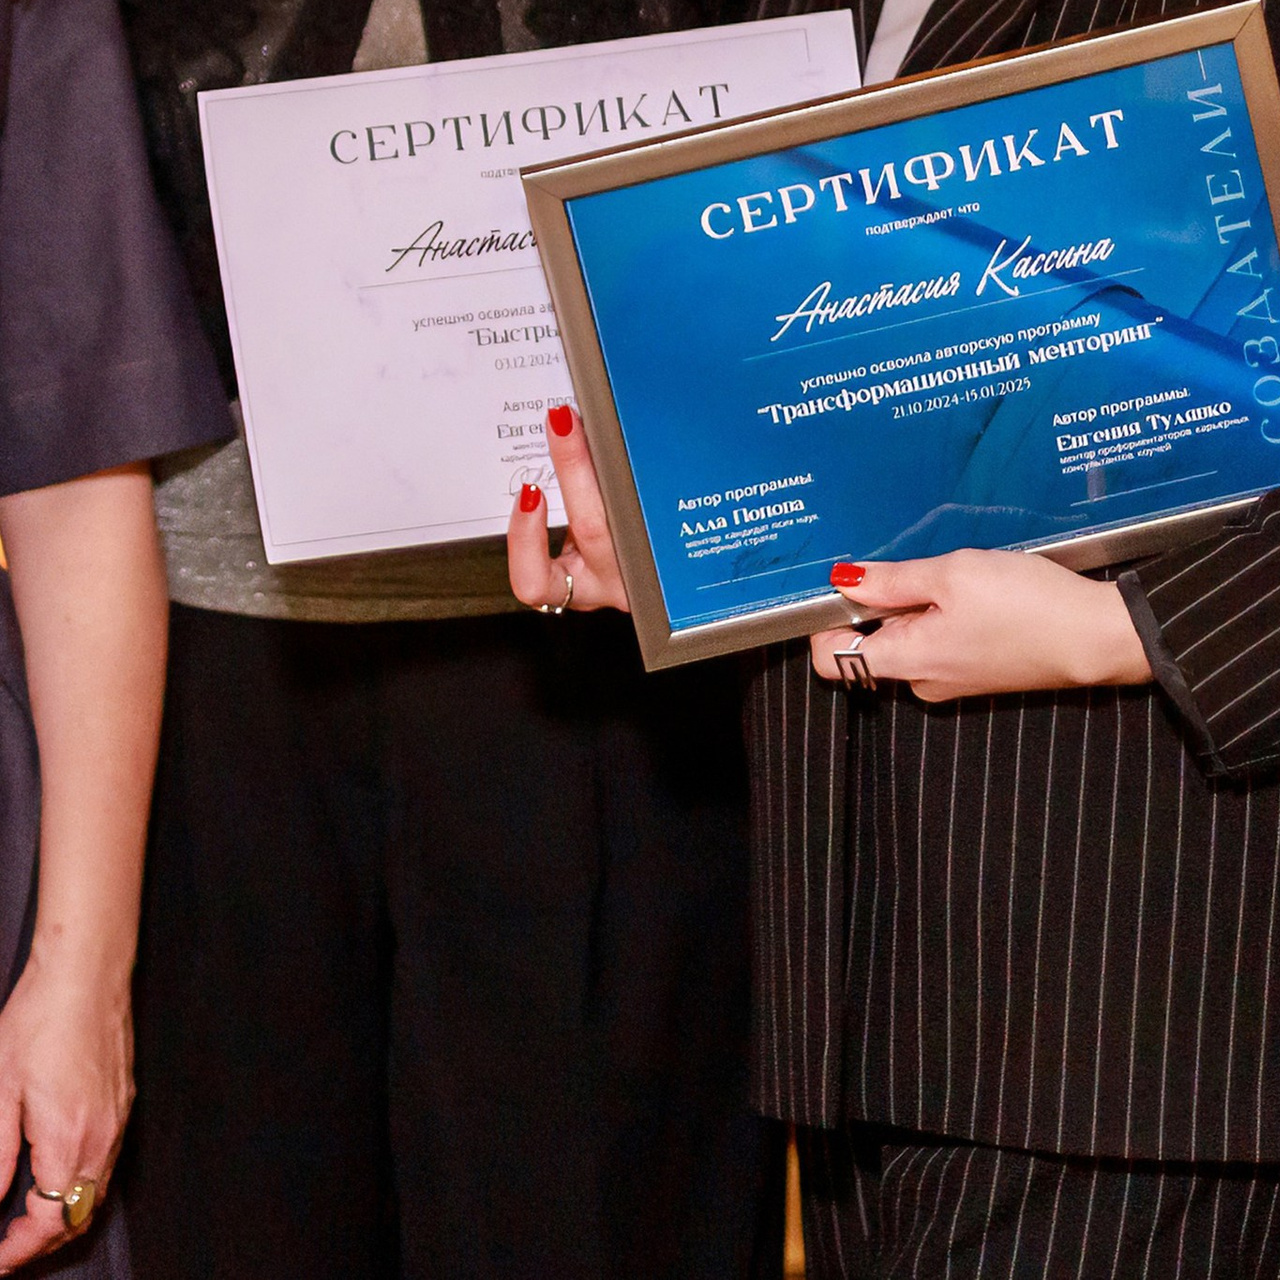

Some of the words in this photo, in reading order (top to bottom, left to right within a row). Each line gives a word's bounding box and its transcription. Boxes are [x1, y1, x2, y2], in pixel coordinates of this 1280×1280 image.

[329, 83, 730, 165] СЕРТИФИКАТ
[700, 109, 1124, 239] СЕРТИФИКАТ
[770, 270, 961, 342] Анастасия
[975, 235, 1116, 298] Кассина
[478, 305, 535, 321] освоила
[800, 366, 867, 394] успешно
[870, 350, 932, 375] освоила
[935, 332, 1014, 360] авторскую
[1017, 312, 1101, 343] программу
[891, 376, 1032, 420] 21.10.2024-15.01.2025
[1052, 407, 1098, 427] Автор
[1056, 421, 1142, 452] Евгения
[678, 493, 722, 512] Автор
[679, 516, 728, 538] Алла
[732, 498, 805, 526] Попова
